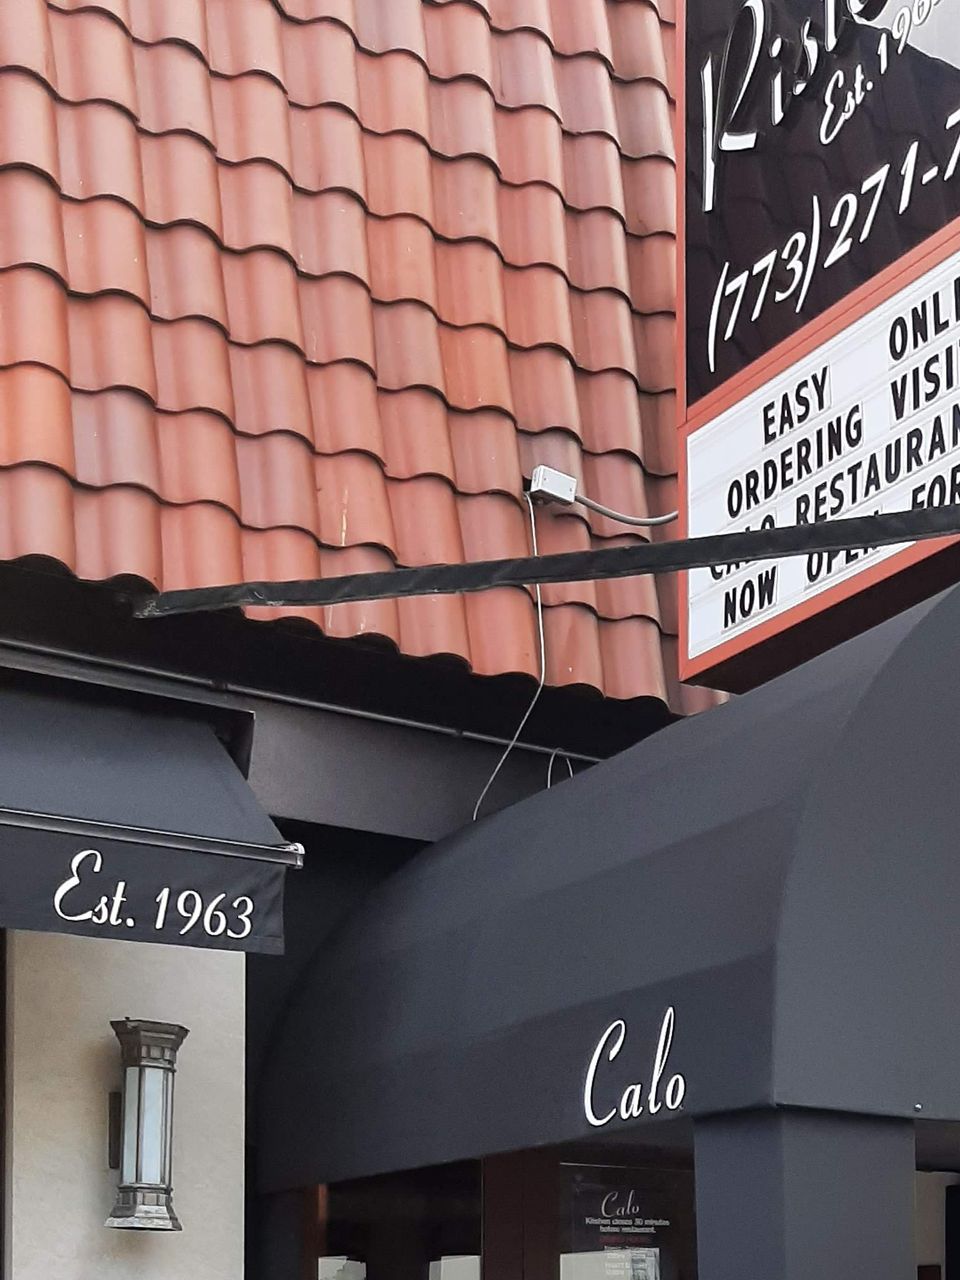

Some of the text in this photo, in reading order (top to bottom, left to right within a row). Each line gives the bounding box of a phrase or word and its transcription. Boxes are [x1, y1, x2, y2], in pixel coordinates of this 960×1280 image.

[819, 0, 942, 145] Est. 196
[762, 365, 829, 446] EASY
[726, 403, 863, 520] ORDERING
[723, 565, 777, 629] NOW
[53, 849, 255, 939] Est. 1963
[583, 1005, 687, 1127] Calo
[600, 1189, 641, 1218] Calo
